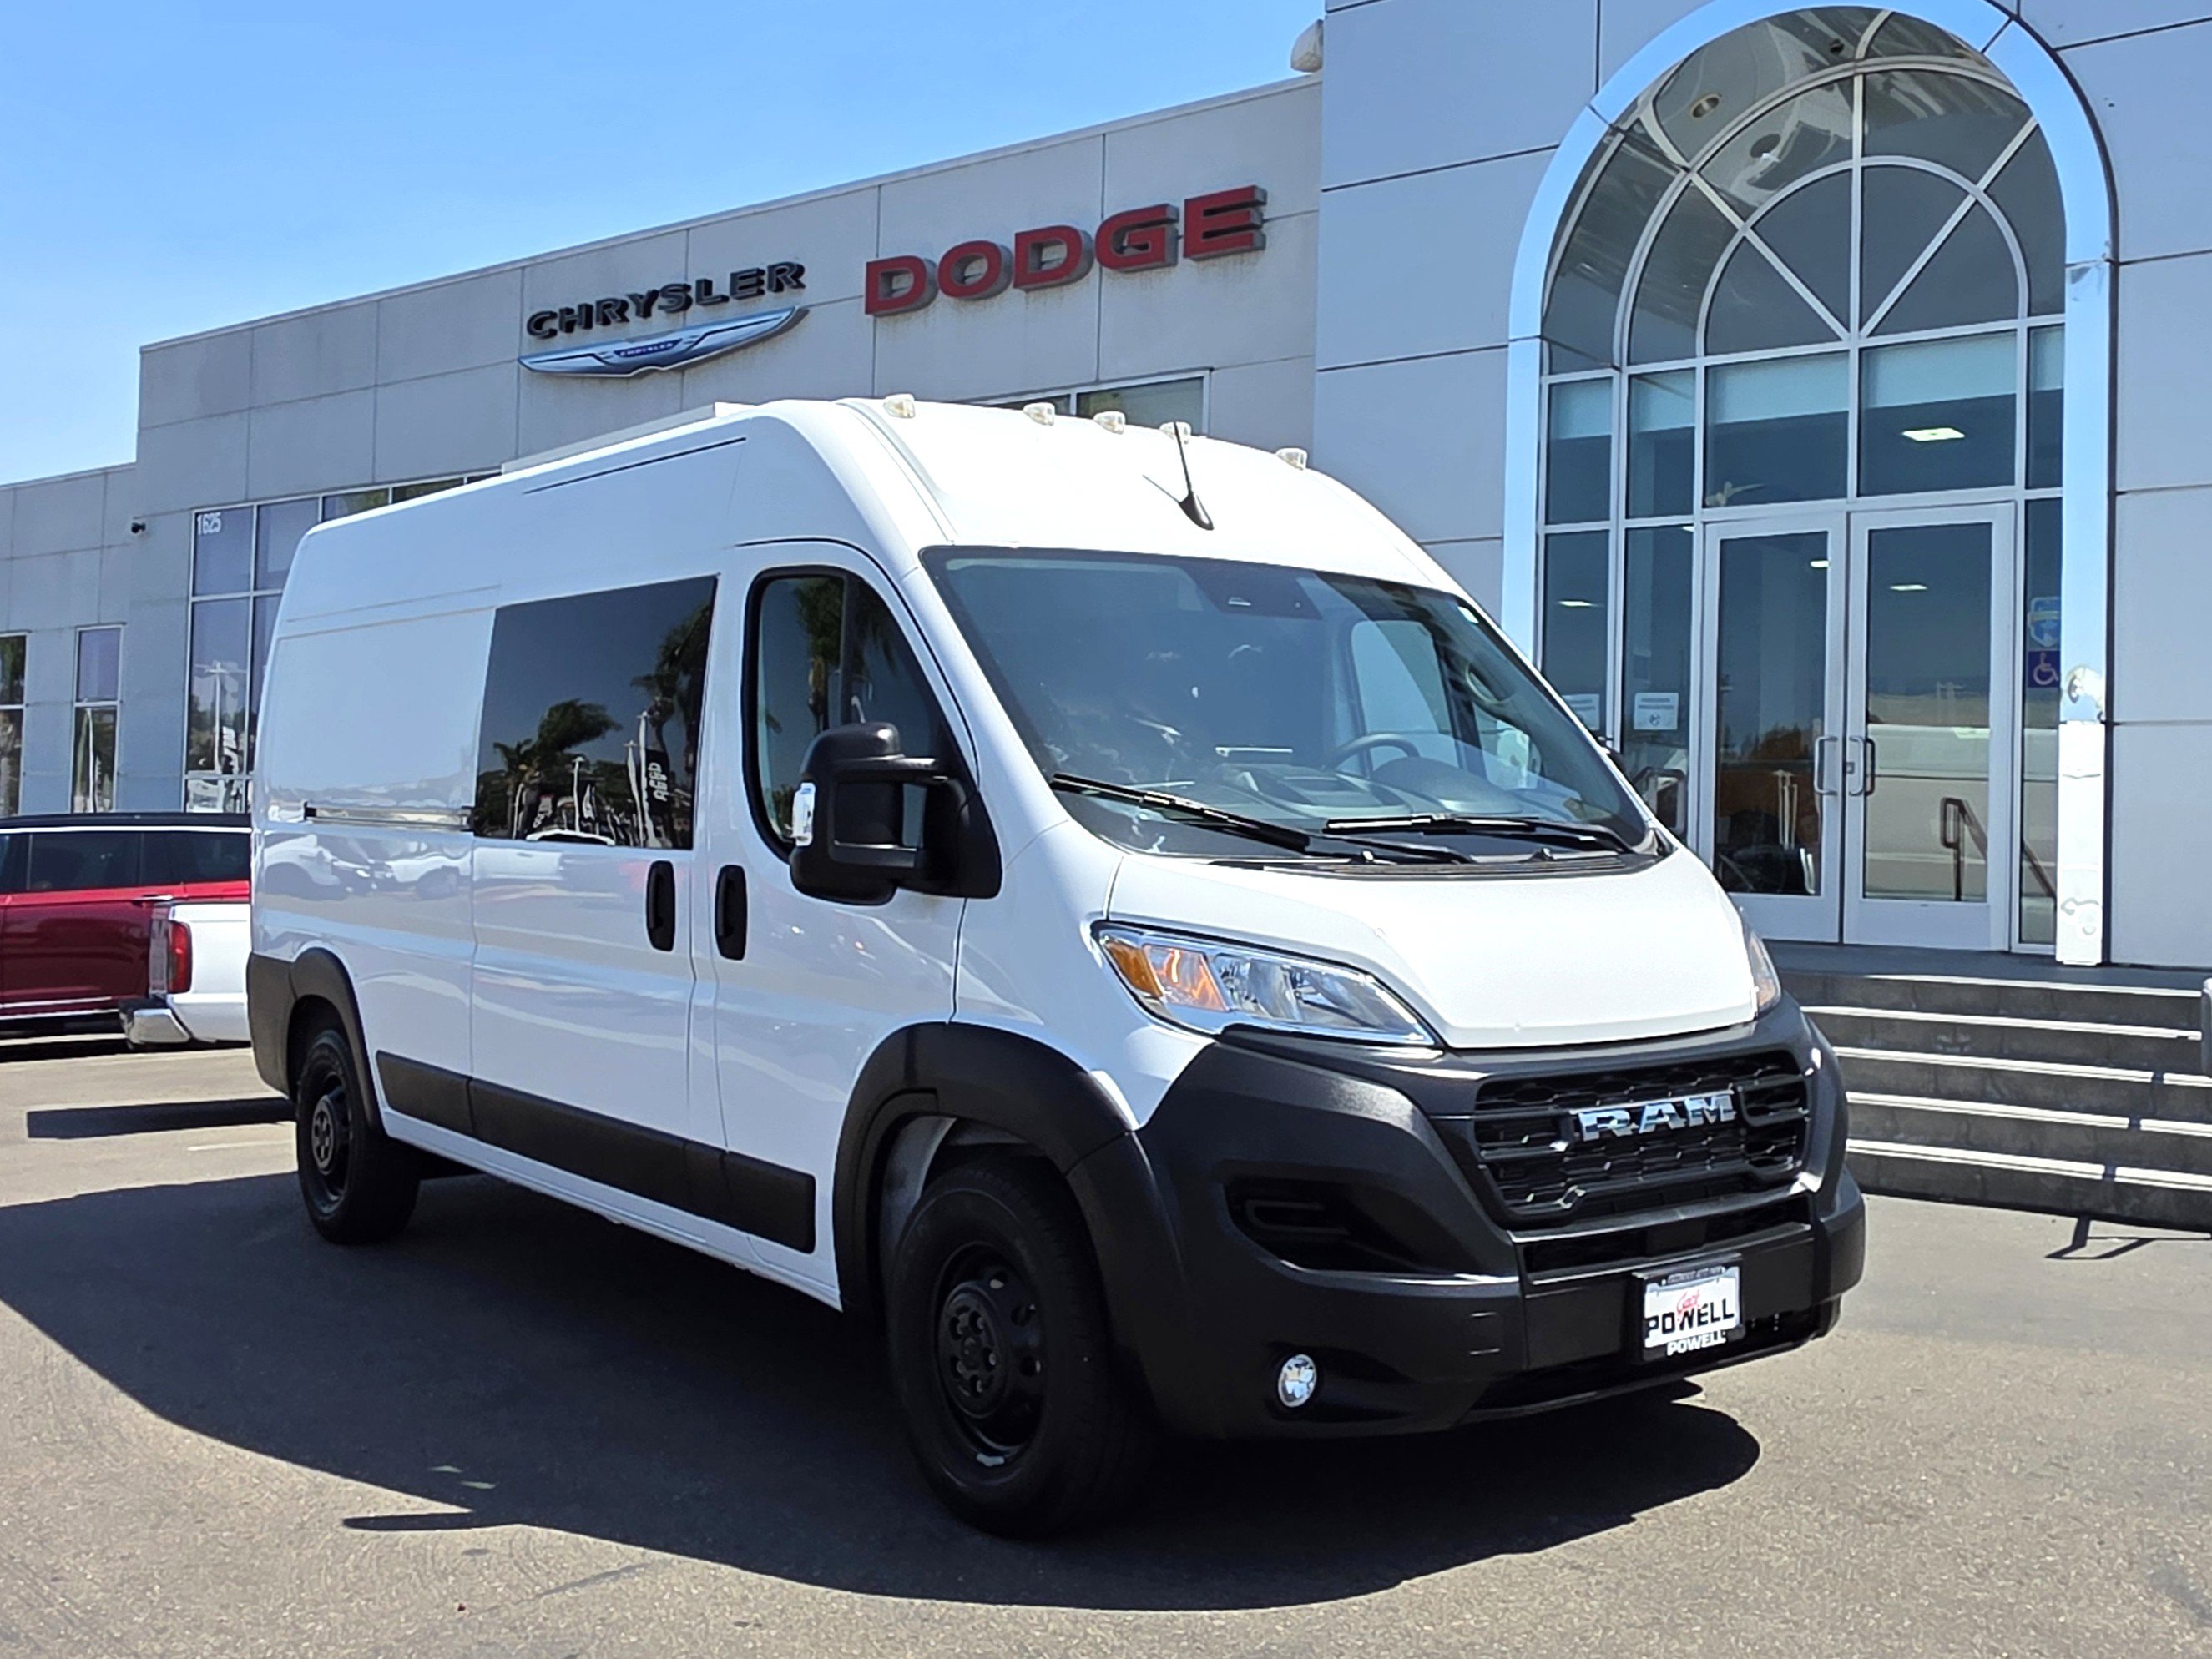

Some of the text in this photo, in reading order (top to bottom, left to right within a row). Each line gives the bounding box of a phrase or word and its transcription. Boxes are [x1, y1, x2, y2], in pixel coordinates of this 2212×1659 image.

[865, 185, 1265, 316] DODGE
[527, 261, 806, 339] CHRYSLER
[197, 512, 222, 535] 1625
[1578, 1094, 1737, 1142] RAM
[1646, 1298, 1735, 1334] POWELL
[1666, 1330, 1727, 1357] POWELL
